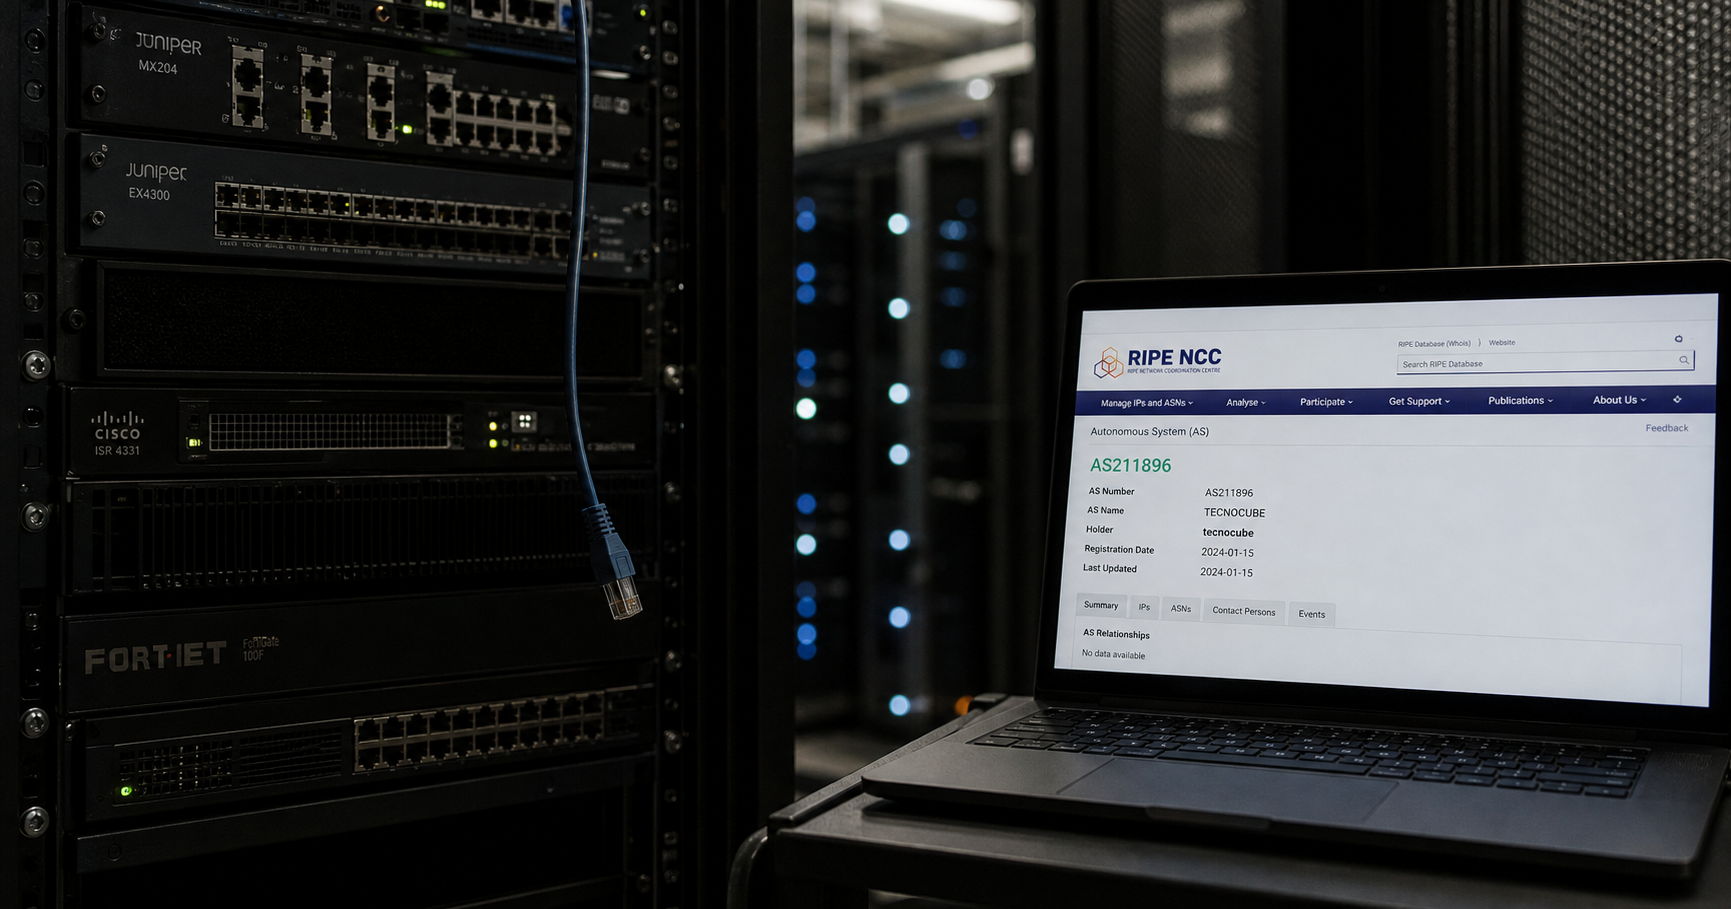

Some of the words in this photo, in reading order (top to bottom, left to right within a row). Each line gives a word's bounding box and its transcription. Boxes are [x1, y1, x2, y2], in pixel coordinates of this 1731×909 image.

[138, 59, 178, 75] MX204
[128, 187, 171, 201] EX4300
[1398, 340, 1414, 348] RIPE
[1415, 340, 1445, 348] Database
[1489, 339, 1516, 347] Website
[1128, 349, 1174, 366] RIPE
[1179, 348, 1222, 365] NCC
[1402, 360, 1428, 369] Search
[1429, 360, 1447, 368] RIPE
[1448, 360, 1483, 368] Database
[1101, 399, 1132, 409] Manage
[1133, 399, 1146, 408] IPs
[1147, 399, 1163, 407] and
[1164, 398, 1186, 407] ASNs
[1226, 398, 1259, 409] Analyse
[1300, 397, 1346, 408] Participate
[1389, 397, 1405, 406] Get
[1407, 396, 1442, 408] Support
[1488, 396, 1545, 405] Publications
[1593, 395, 1622, 405] About
[1624, 395, 1638, 405] Us
[1091, 426, 1149, 436] Autonomous
[1151, 426, 1186, 438] System
[1188, 426, 1210, 437] (AS)
[1646, 423, 1689, 432] Feedback
[94, 428, 141, 440] CISCO
[95, 445, 113, 456] ISR
[115, 445, 140, 456] 4331
[1090, 457, 1172, 473] AS211896
[1088, 487, 1101, 496] AS
[1102, 487, 1135, 496] Number
[1205, 488, 1254, 498] AS211896
[1087, 506, 1099, 514] AS
[1100, 506, 1125, 515] Name
[1204, 507, 1266, 518] TECNOCUBE
[1086, 525, 1114, 534] Holder
[1203, 527, 1254, 538] tecnocube
[1084, 545, 1134, 556] Registration
[1134, 546, 1155, 555] Date
[1201, 547, 1254, 558] 2024-01-15
[1083, 563, 1101, 573] Last
[1102, 564, 1137, 574] Updated
[1200, 567, 1253, 578] 2024-01-15
[1084, 601, 1119, 611] Summary
[1138, 603, 1151, 612] IPs
[1171, 604, 1192, 613] ASNs
[1212, 606, 1243, 615] Contact
[1245, 606, 1276, 617] Persons
[1298, 610, 1326, 619] Events
[1083, 629, 1095, 637] AS
[1096, 629, 1151, 641] Relationships
[243, 649, 265, 662] 100F
[1082, 649, 1093, 657] No
[1094, 650, 1110, 658] data
[1111, 650, 1146, 660] available
